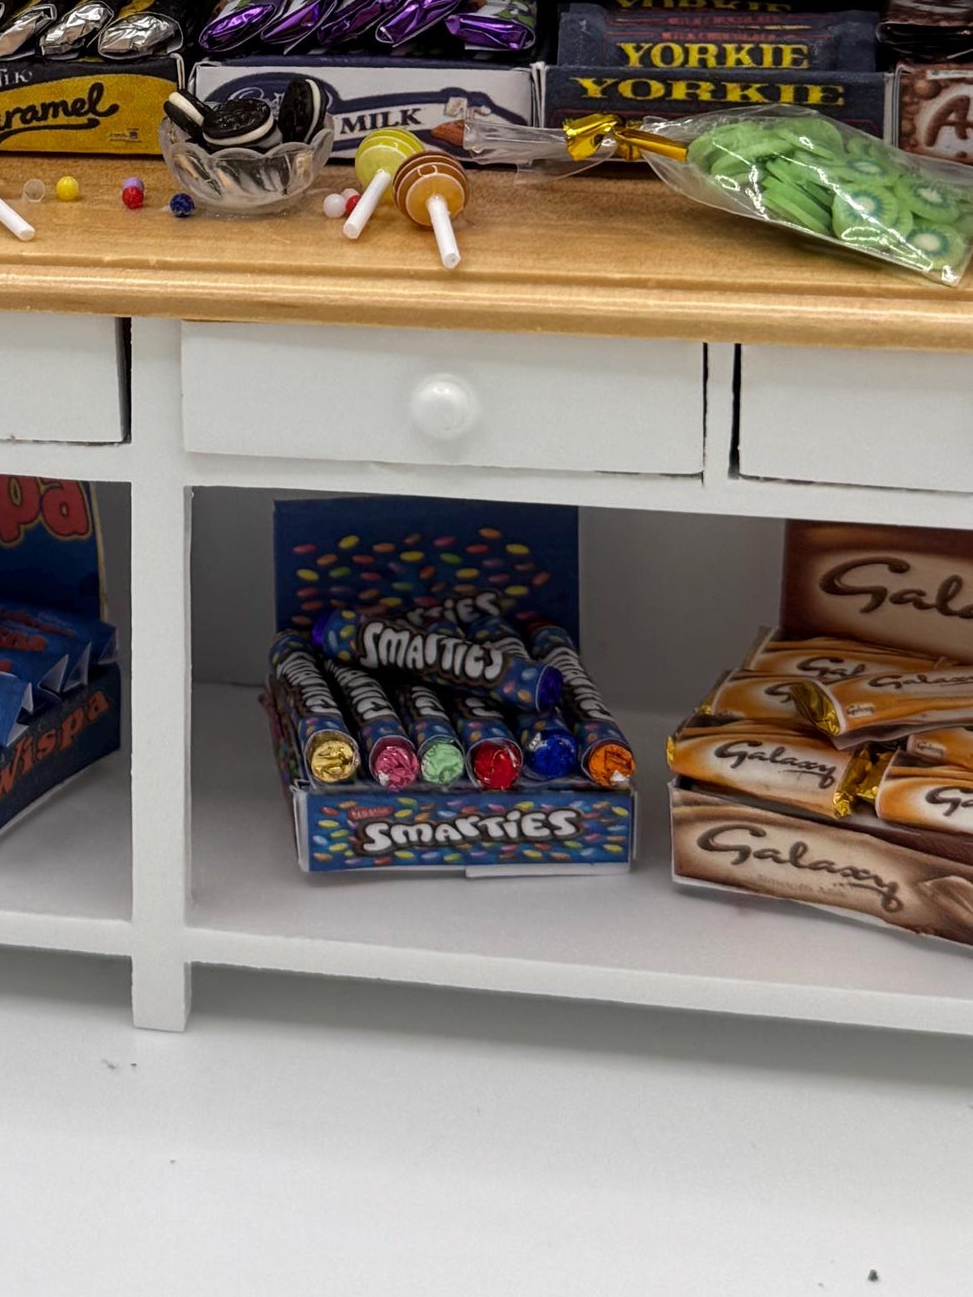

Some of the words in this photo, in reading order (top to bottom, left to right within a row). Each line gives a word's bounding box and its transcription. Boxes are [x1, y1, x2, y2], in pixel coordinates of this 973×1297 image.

[616, 42, 810, 70] YORKIE
[569, 77, 846, 106] YORKIE
[340, 107, 423, 135] MILK
[360, 622, 505, 680] SMARTIES
[713, 739, 837, 790] Galaxy
[363, 808, 579, 853] SMARTIES
[696, 823, 905, 913] Galaxy
